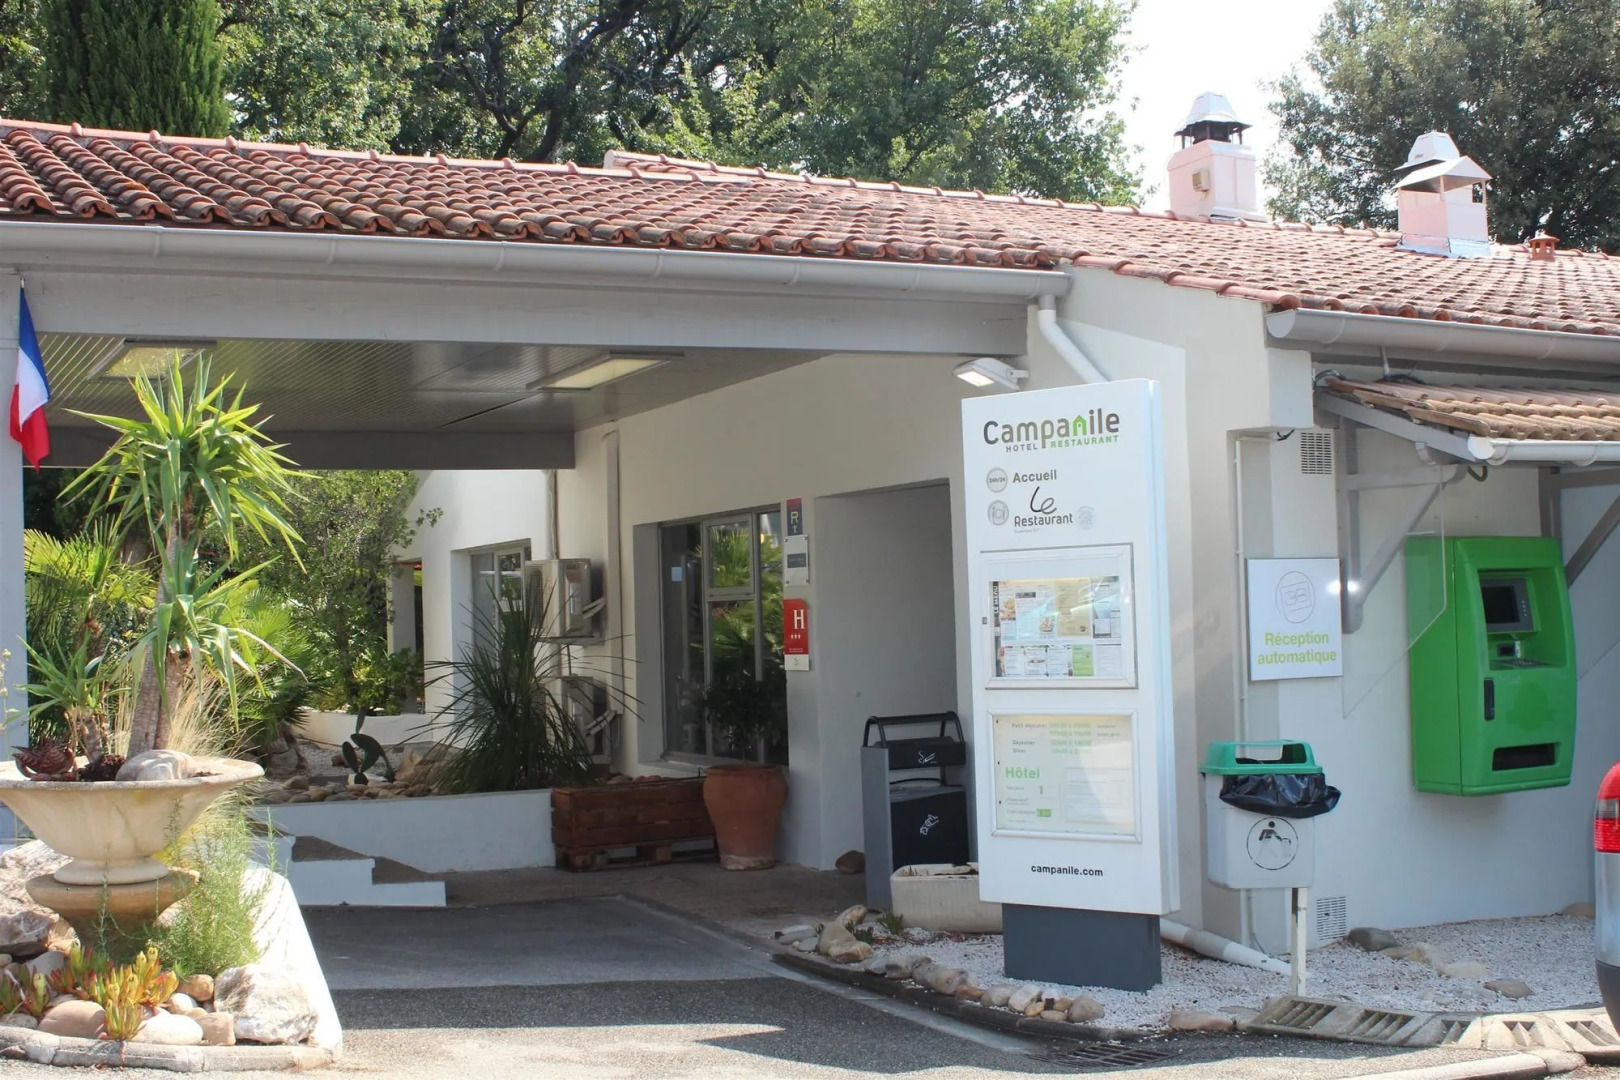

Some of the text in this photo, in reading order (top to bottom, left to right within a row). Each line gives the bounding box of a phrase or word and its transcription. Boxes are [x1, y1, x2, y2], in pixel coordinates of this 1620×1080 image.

[983, 408, 1120, 449] Campanile
[1006, 434, 1119, 453] HOTEL RESTAURANT
[1012, 469, 1057, 484] Accueil
[1030, 486, 1057, 515] Le
[1014, 512, 1073, 528] Restaurant
[793, 609, 806, 630] H
[1264, 631, 1330, 647] Réception
[1257, 649, 1337, 665] automatique
[1005, 766, 1041, 779] Hôtel
[1030, 864, 1104, 877] campanile.com
